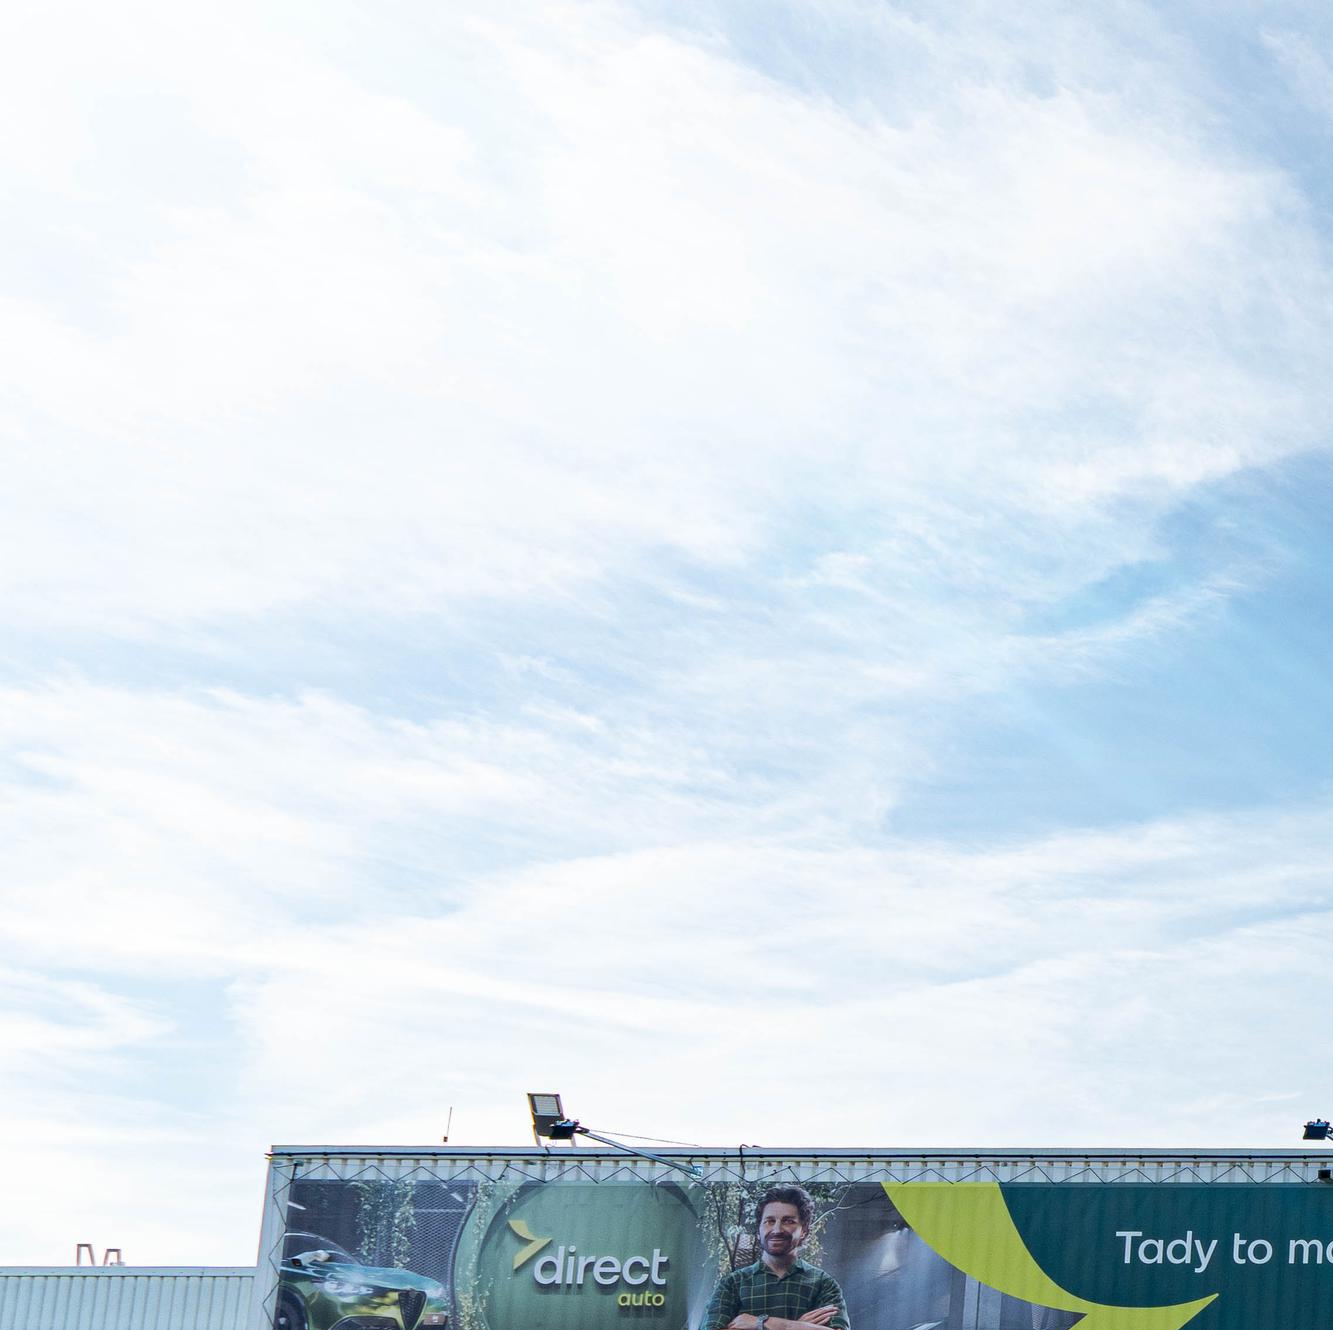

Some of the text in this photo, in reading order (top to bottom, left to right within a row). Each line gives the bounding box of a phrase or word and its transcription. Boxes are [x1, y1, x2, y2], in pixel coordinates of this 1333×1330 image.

[534, 1245, 669, 1285] direct
[1115, 1230, 1218, 1273] Tady
[1233, 1232, 1273, 1265] to
[618, 1290, 665, 1306] auto
